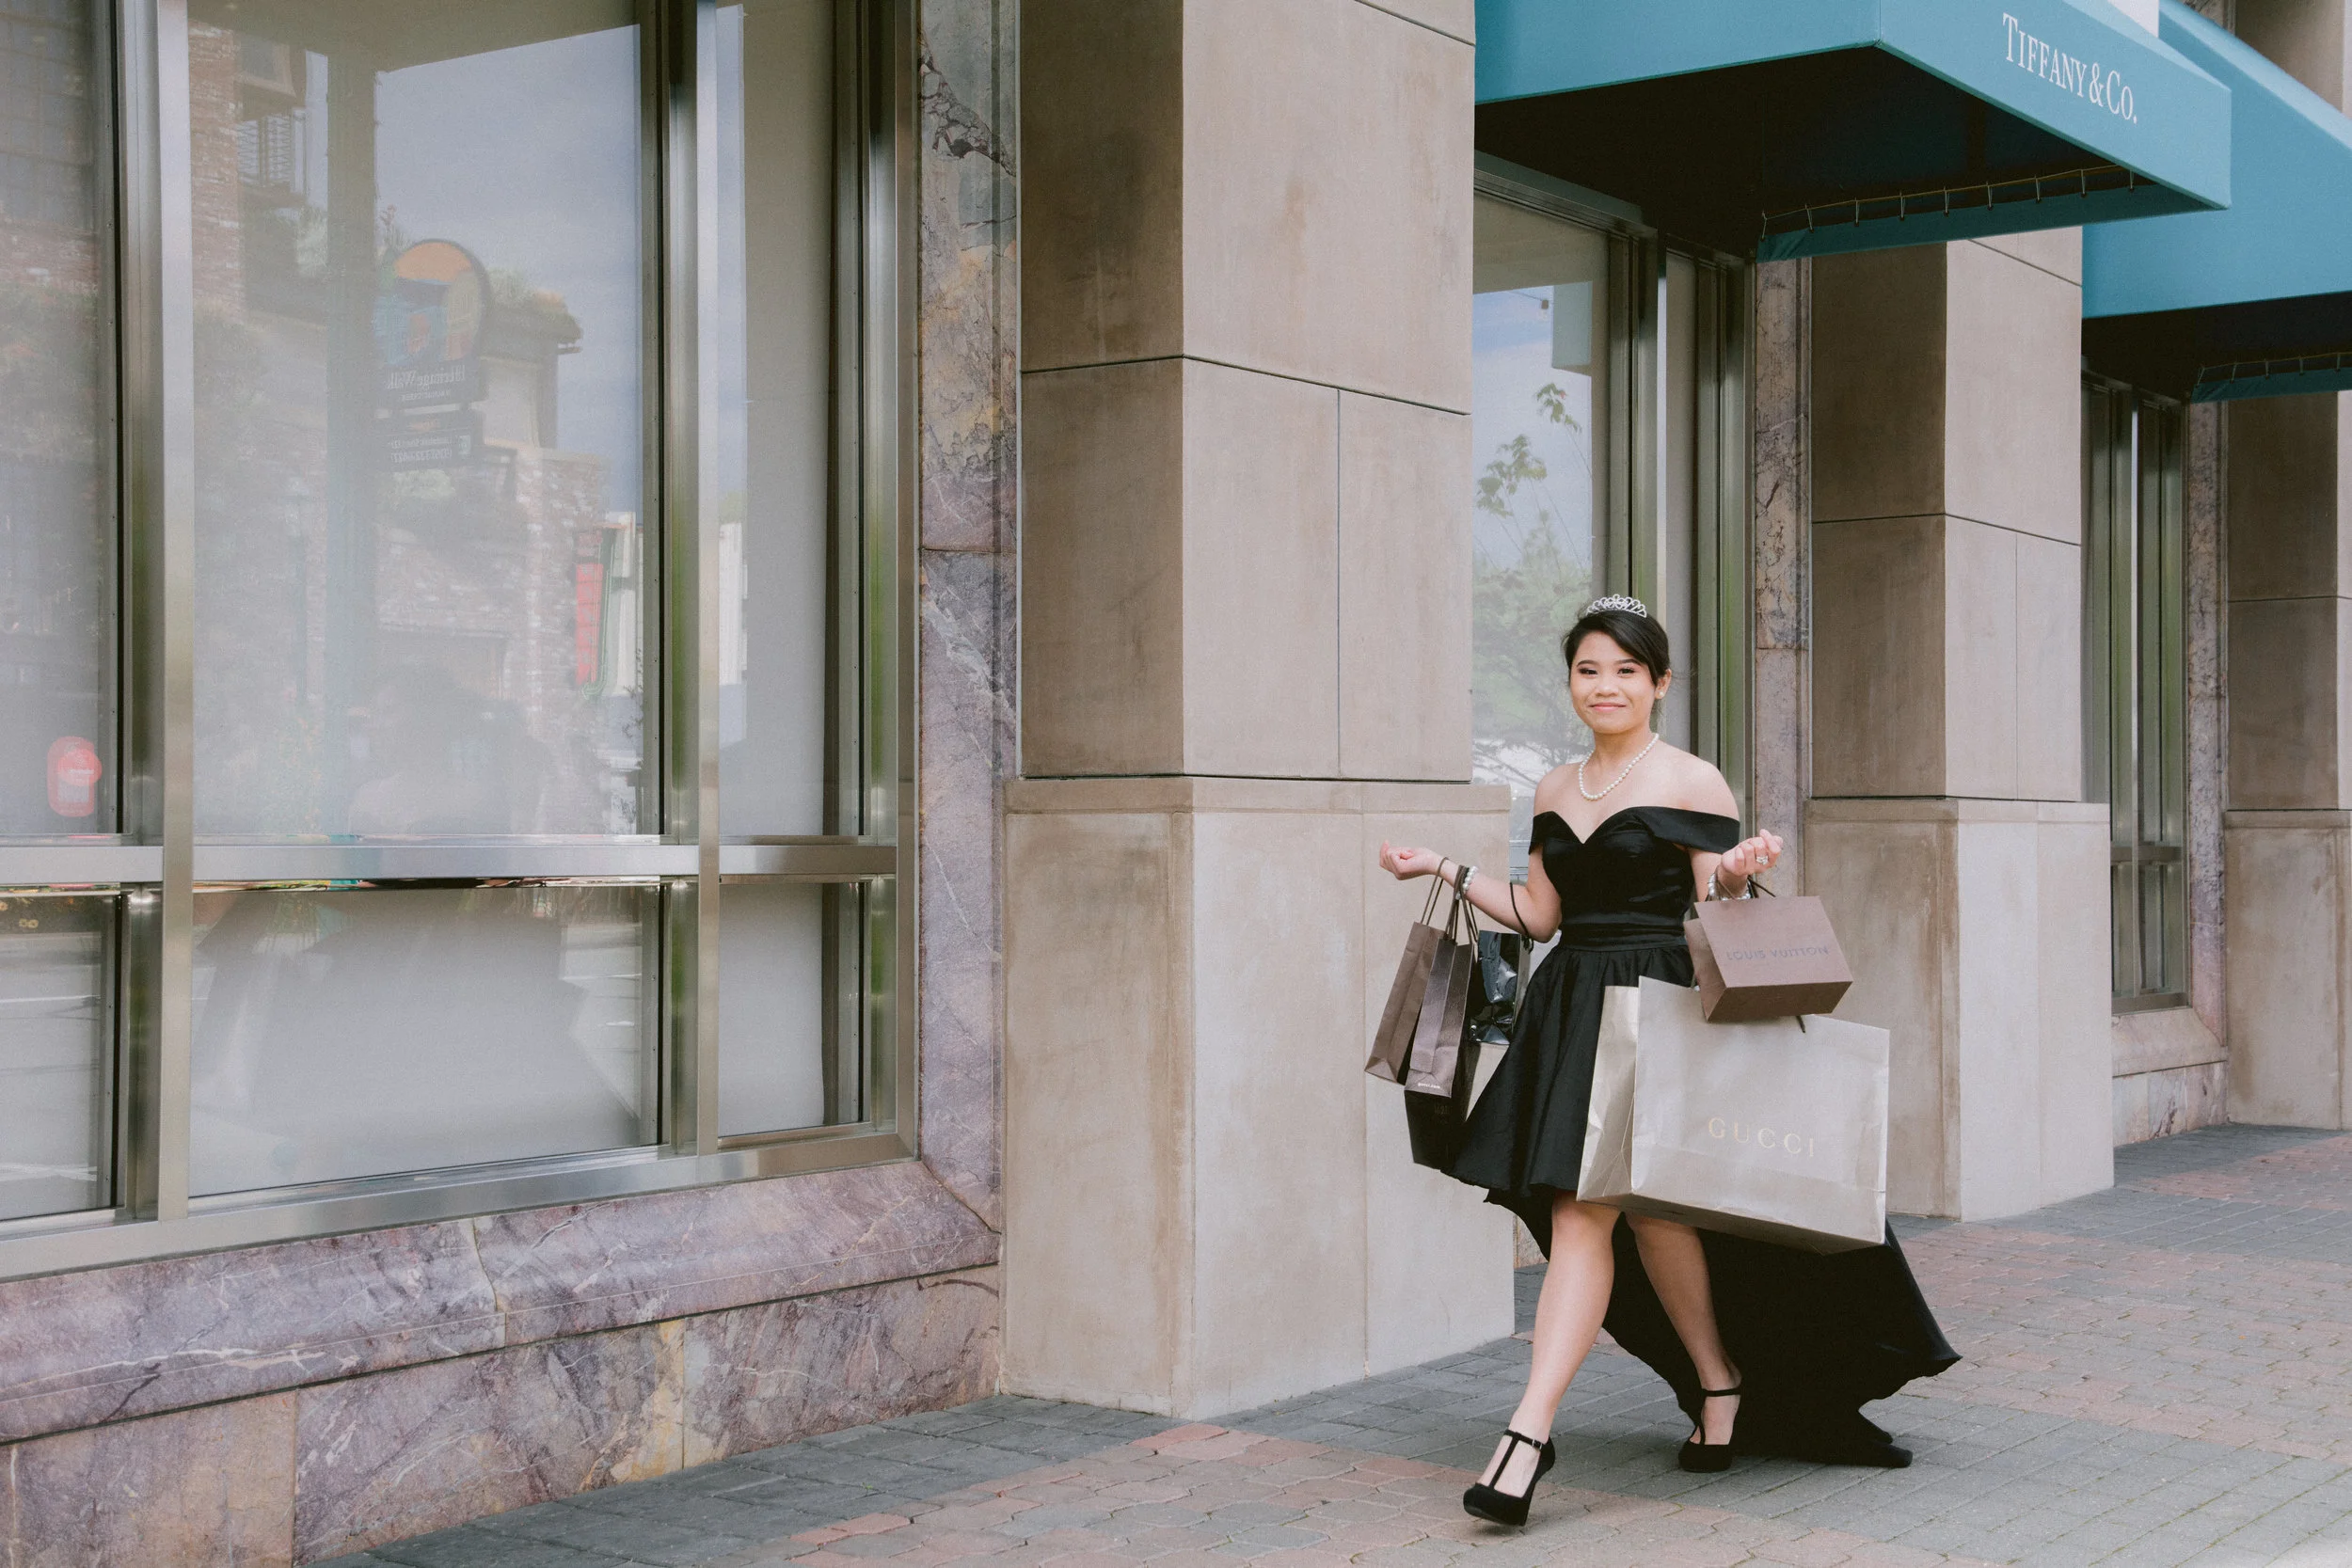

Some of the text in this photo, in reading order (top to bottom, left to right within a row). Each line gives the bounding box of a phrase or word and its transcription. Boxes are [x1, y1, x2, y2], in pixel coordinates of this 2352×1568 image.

[1725, 944, 1830, 961] LOUIS VUITTON
[1708, 1117, 1815, 1158] GUCCI
